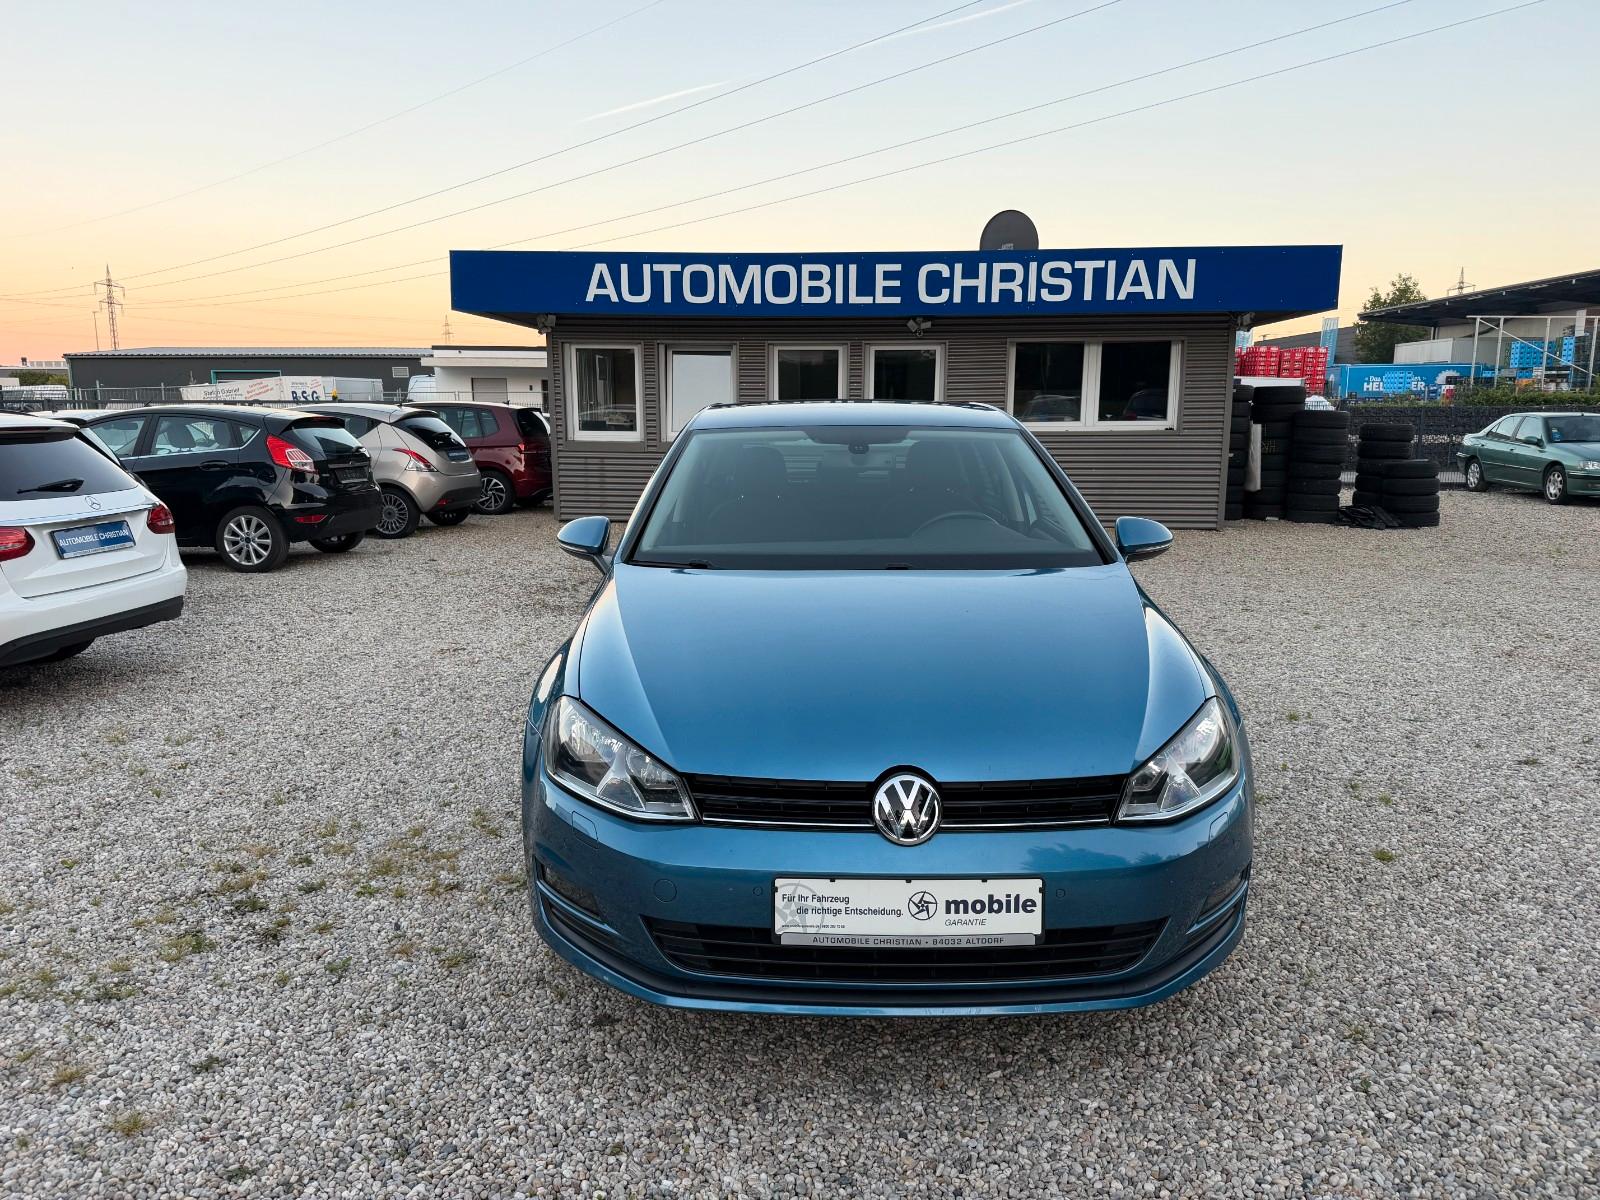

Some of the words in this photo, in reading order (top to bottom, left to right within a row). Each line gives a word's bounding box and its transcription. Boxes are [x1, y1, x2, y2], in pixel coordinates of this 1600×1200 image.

[585, 263, 902, 305] AUTOMOBILE
[917, 258, 1197, 304] CHRISTIAN
[60, 534, 99, 546] AUTOMOBILE
[100, 529, 129, 539] CHRISTIAN
[782, 893, 796, 903] Für
[798, 893, 809, 903] Ihr
[811, 893, 850, 905] Fahrzeug
[945, 893, 1037, 915] mobile
[796, 906, 809, 915] die
[811, 906, 843, 917] richtige
[844, 906, 904, 918] Entscheidung.
[944, 918, 987, 927] GARANTIE
[812, 936, 870, 946] AUTOMOBILE
[873, 938, 922, 946] CHRISTIAN
[932, 938, 962, 946] 84032
[965, 937, 1004, 945] ALTDORF
